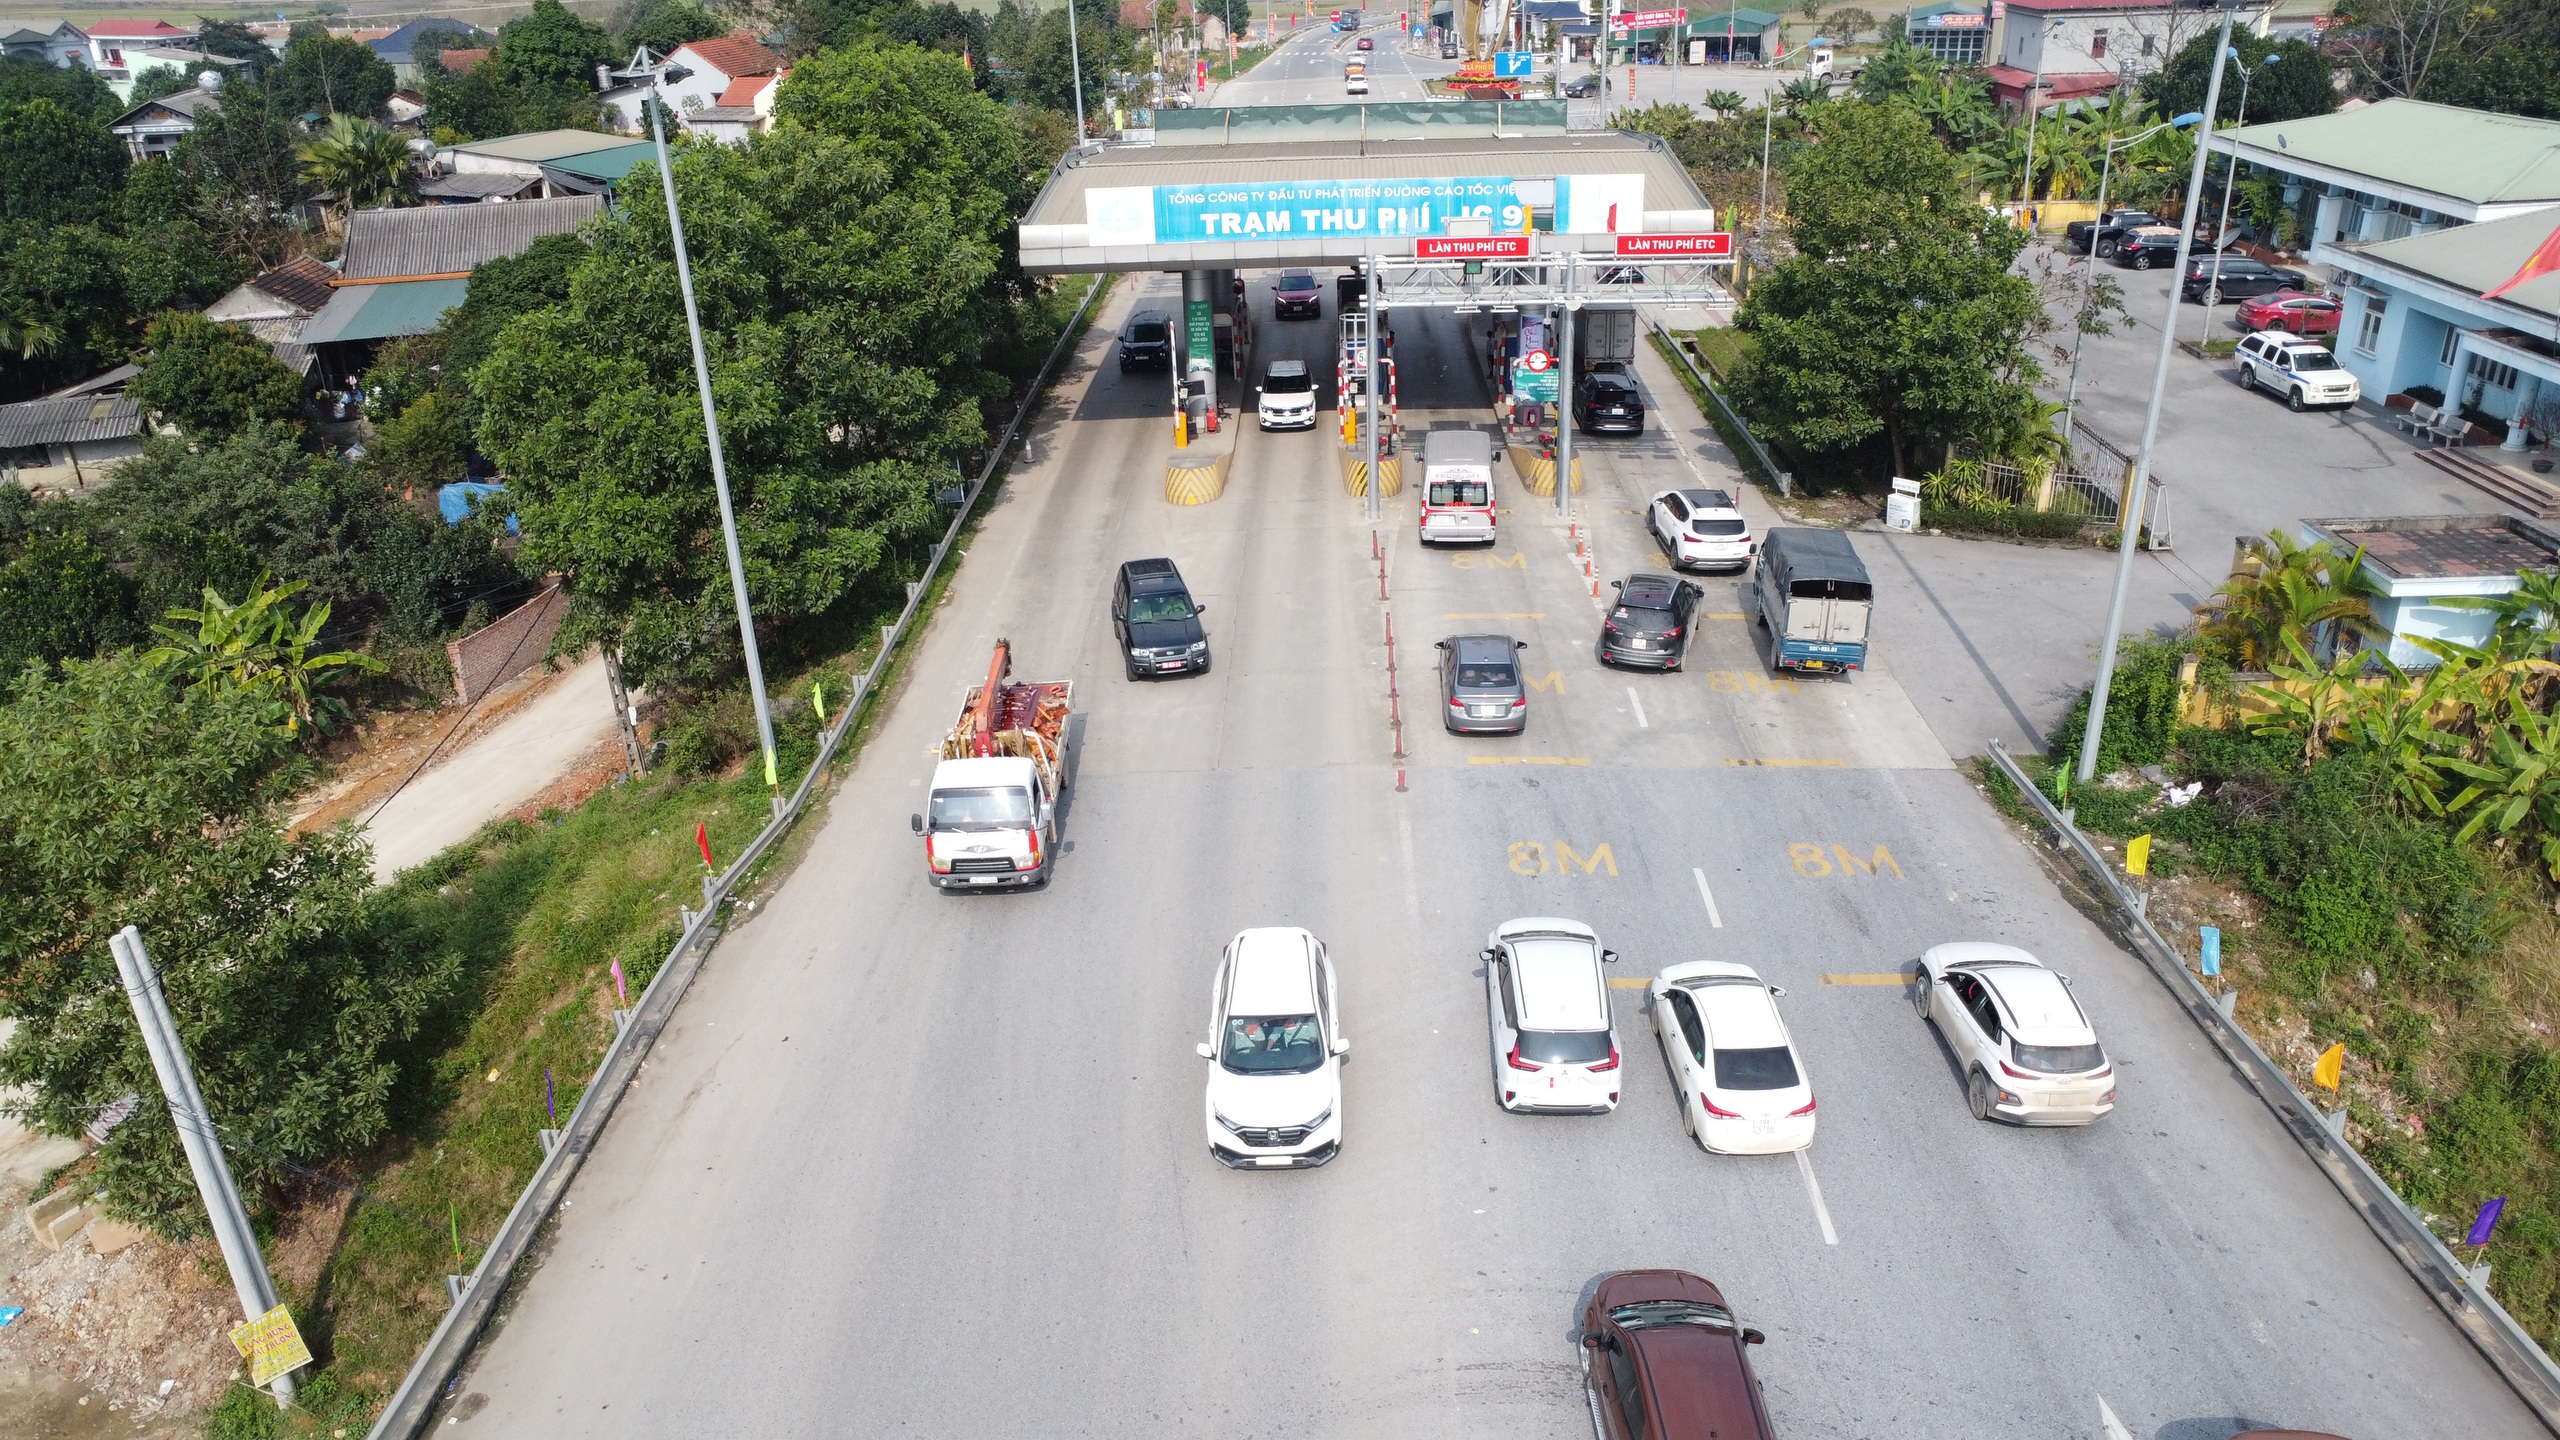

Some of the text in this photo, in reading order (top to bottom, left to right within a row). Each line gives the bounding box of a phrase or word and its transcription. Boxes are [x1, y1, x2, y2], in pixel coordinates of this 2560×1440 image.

[1168, 182, 1516, 205] TỔNG CÔNG TY ĐẦU TƯ PHÁT TRIỂN ĐƯỜNG CAO TỐC VIỆ
[1200, 210, 1291, 237] TRẠM
[1301, 208, 1367, 231] THU
[1378, 202, 1431, 231] PHÍ
[1502, 205, 1523, 227] 9
[1429, 239, 1517, 254] LÀN THU PHÍ ETC
[1628, 236, 1716, 250] LÀN THU PHÍ ETC
[1507, 841, 1620, 878] 8M
[1787, 842, 1903, 879] 8M
